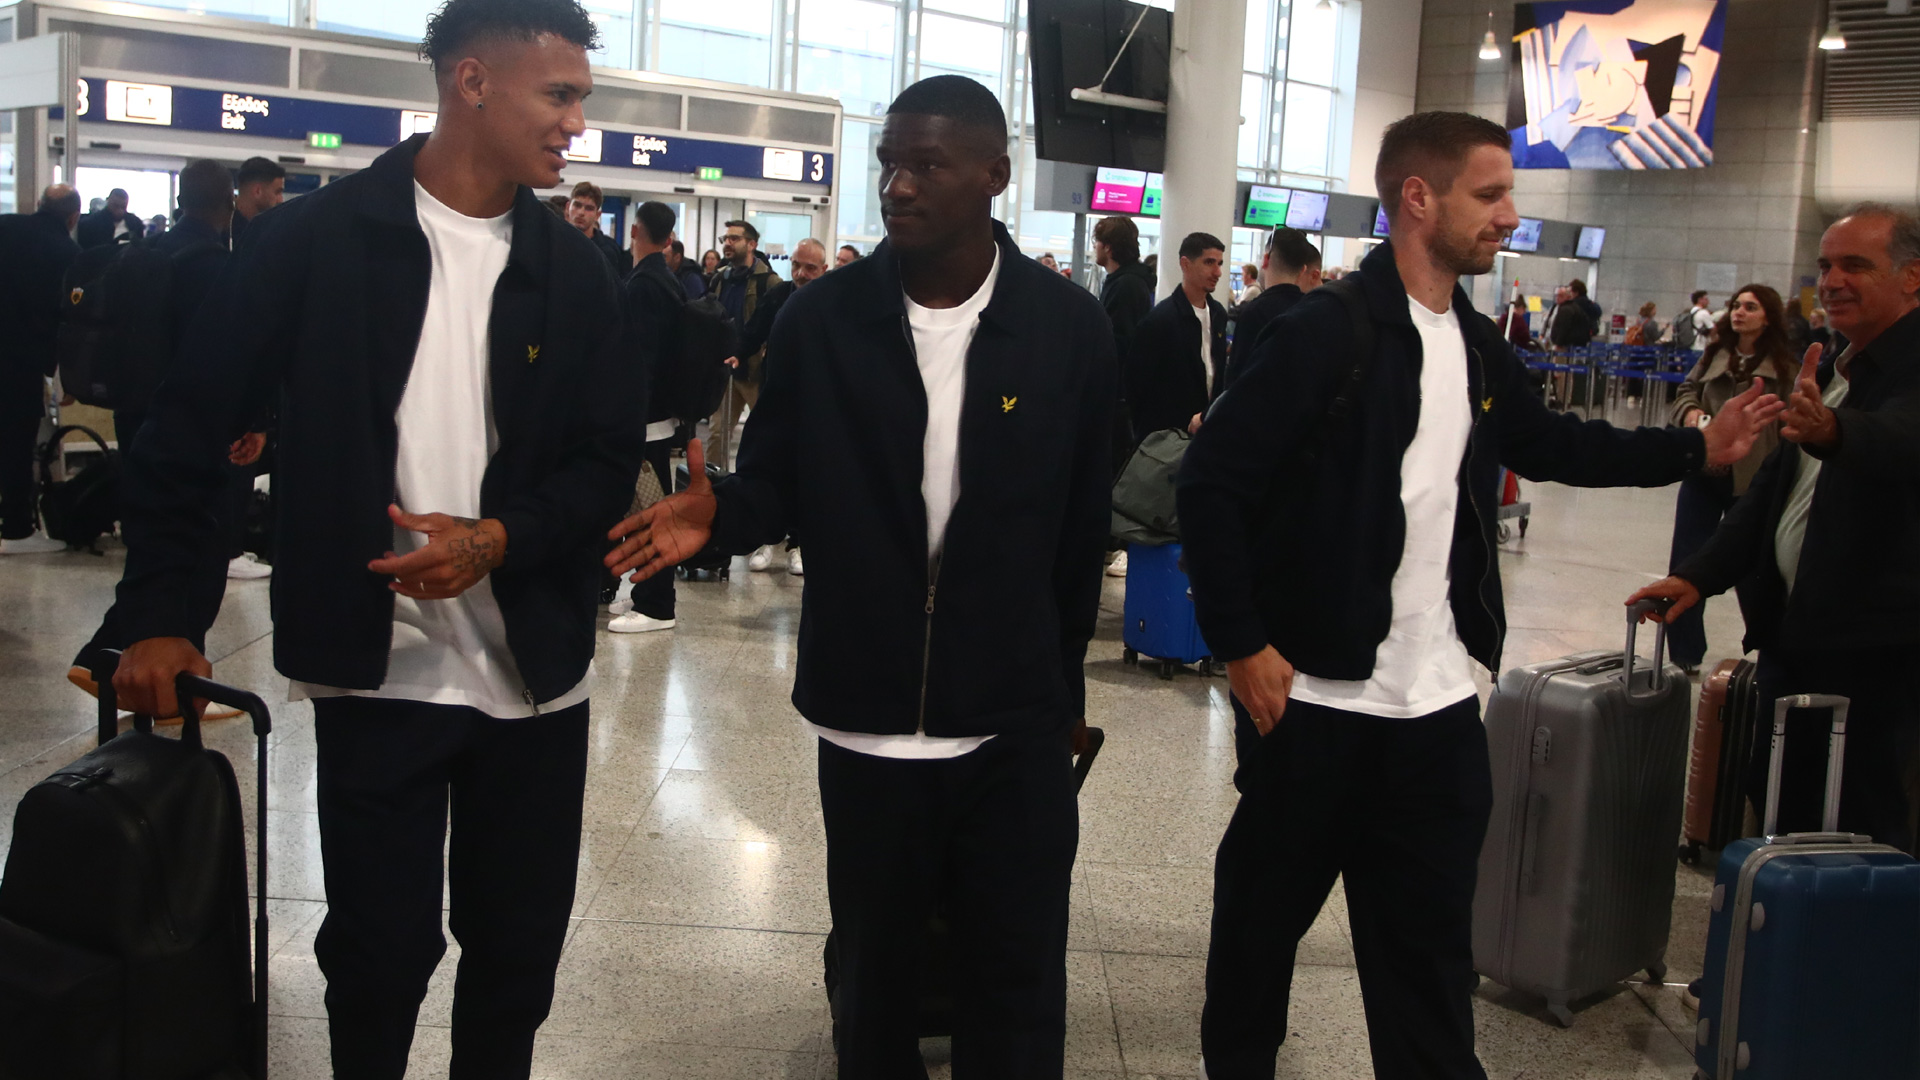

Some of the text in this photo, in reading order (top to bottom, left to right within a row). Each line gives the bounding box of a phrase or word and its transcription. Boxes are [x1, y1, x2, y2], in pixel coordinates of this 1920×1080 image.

[221, 112, 245, 130] Exit
[632, 151, 651, 166] Exit
[811, 154, 824, 181] 3
